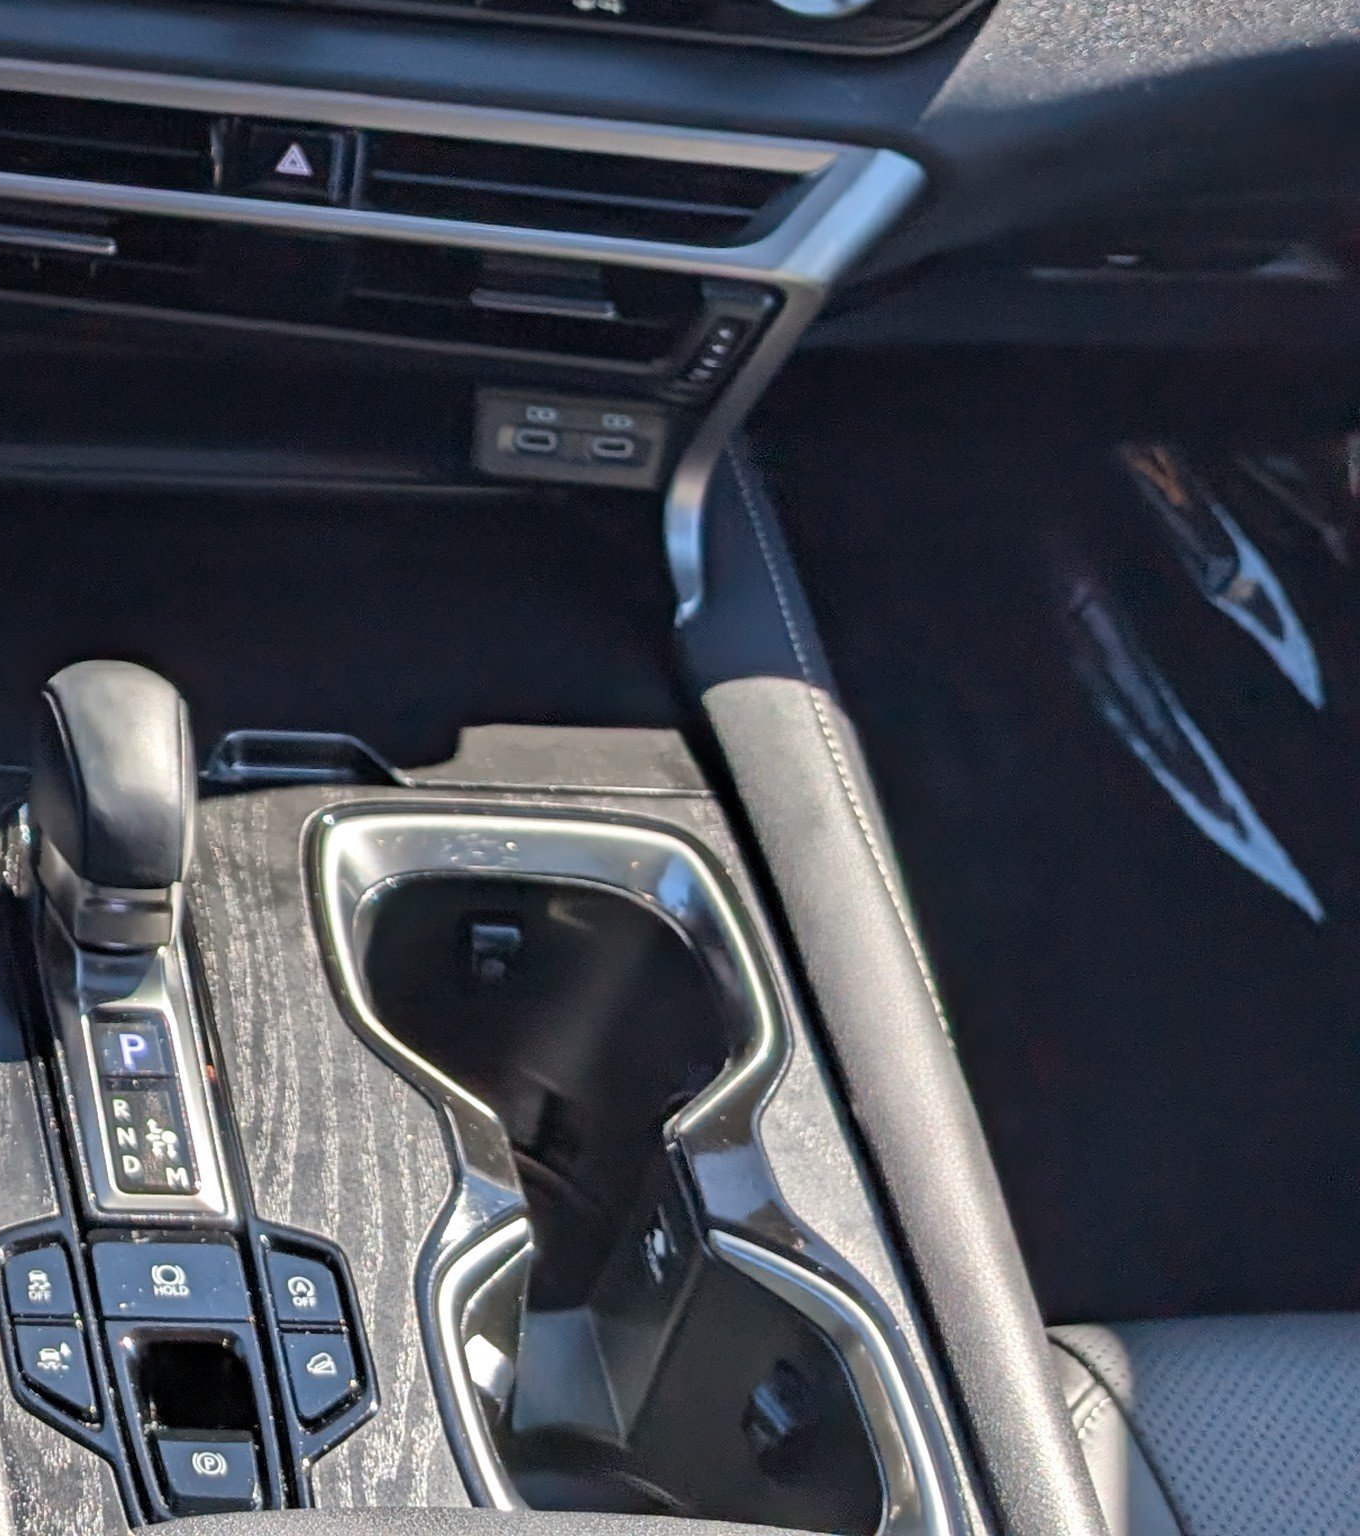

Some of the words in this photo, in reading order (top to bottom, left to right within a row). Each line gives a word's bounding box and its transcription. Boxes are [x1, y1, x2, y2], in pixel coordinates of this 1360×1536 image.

[118, 1033, 146, 1070] P
[111, 1097, 130, 1120] R
[116, 1124, 138, 1149] N
[122, 1154, 142, 1175] D
[164, 1166, 189, 1189] M
[28, 1287, 53, 1300] OFF
[153, 1284, 189, 1297] HOLD
[292, 1294, 317, 1307] OFF
